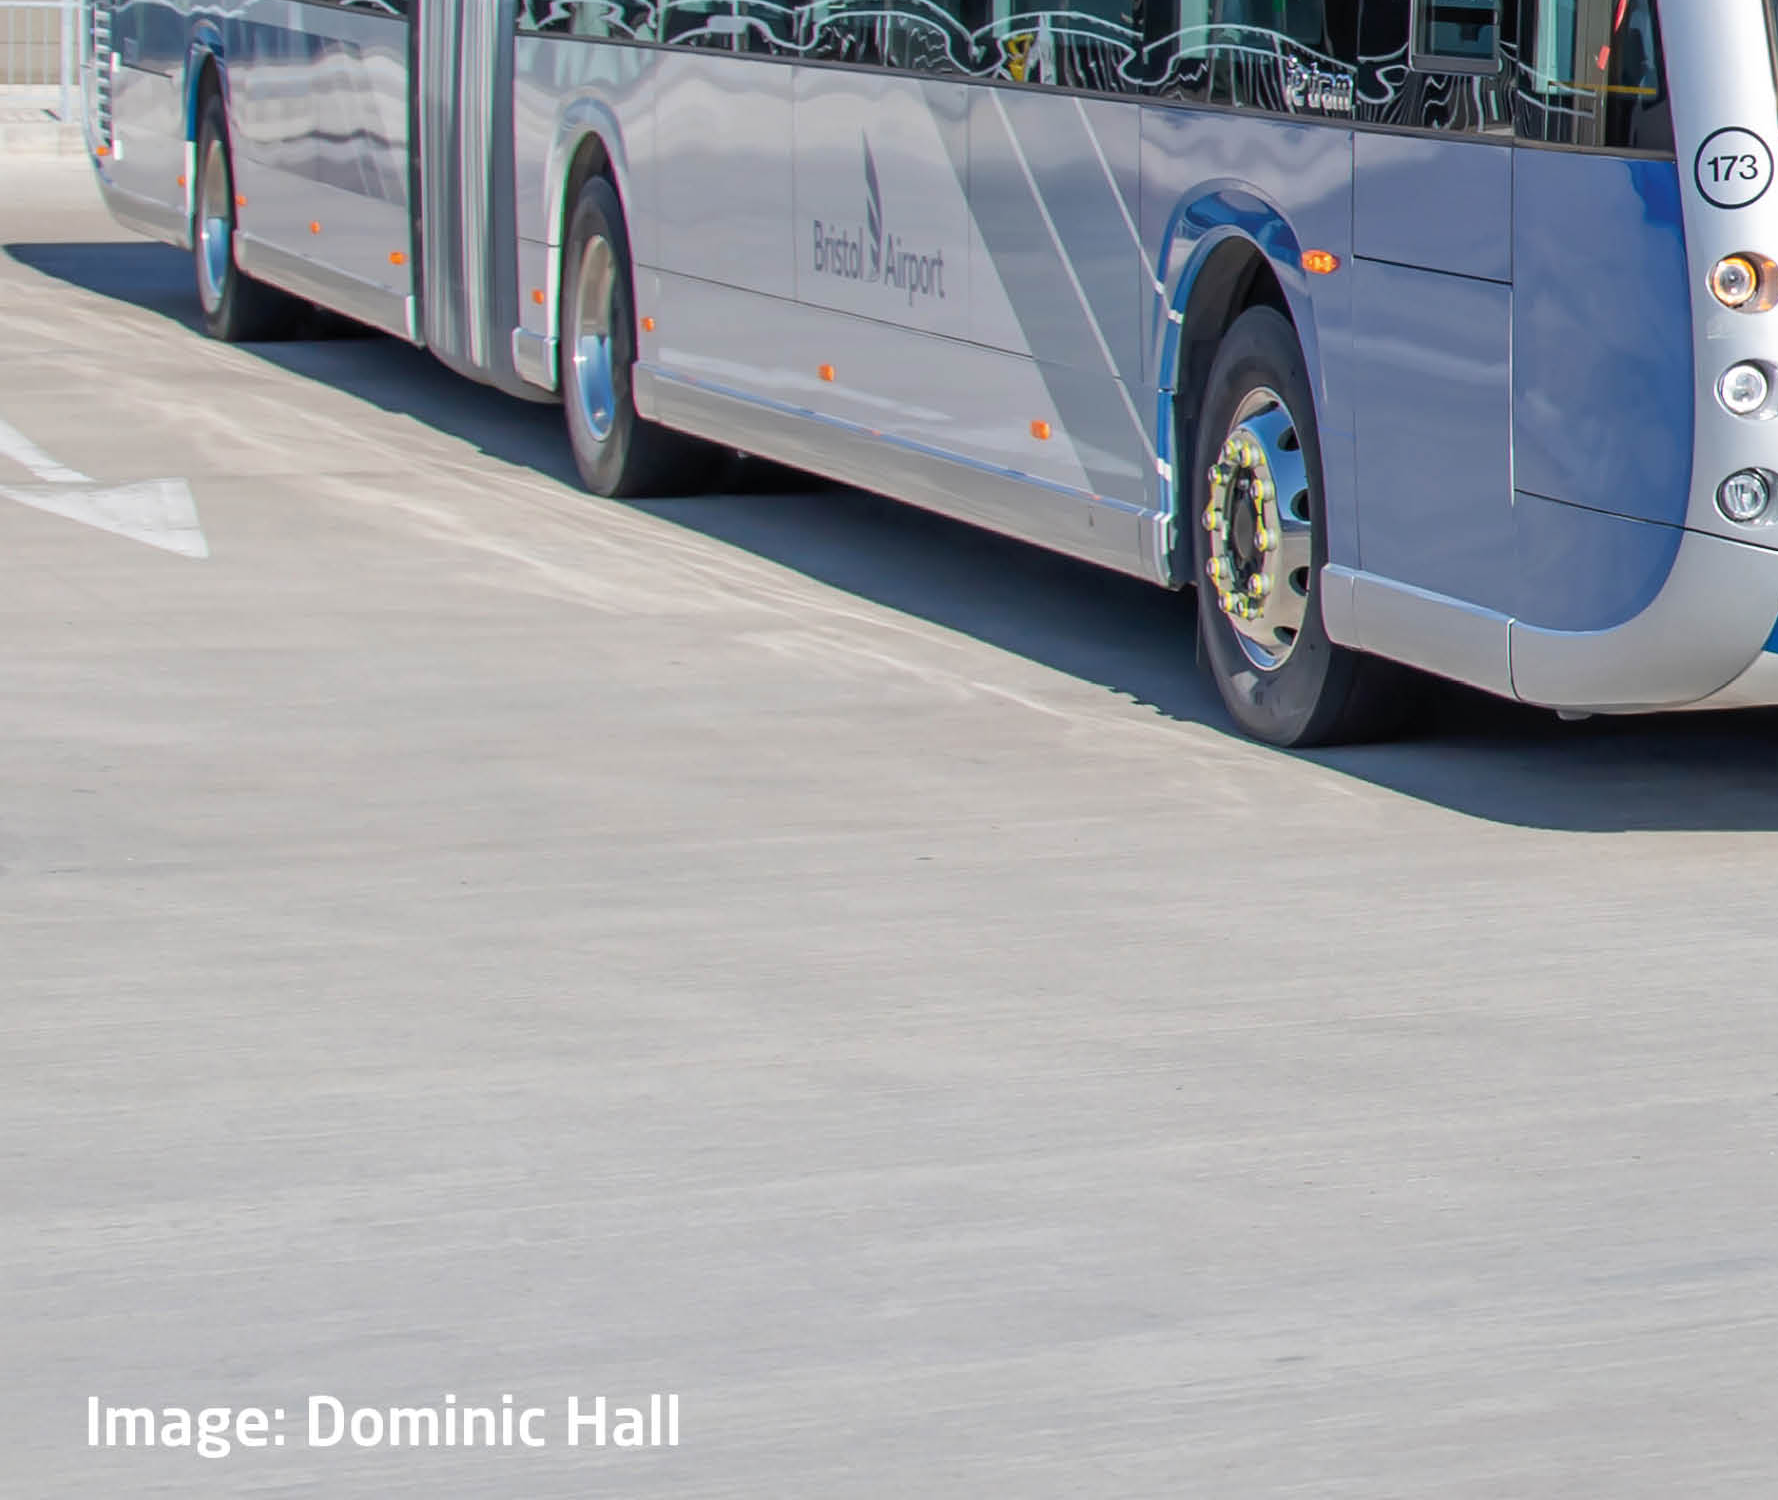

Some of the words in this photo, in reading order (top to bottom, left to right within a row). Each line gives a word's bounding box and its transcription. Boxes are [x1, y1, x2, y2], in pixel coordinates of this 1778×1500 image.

[1707, 154, 1758, 182] 173
[813, 219, 864, 280] Bristol
[884, 234, 945, 306] Airport
